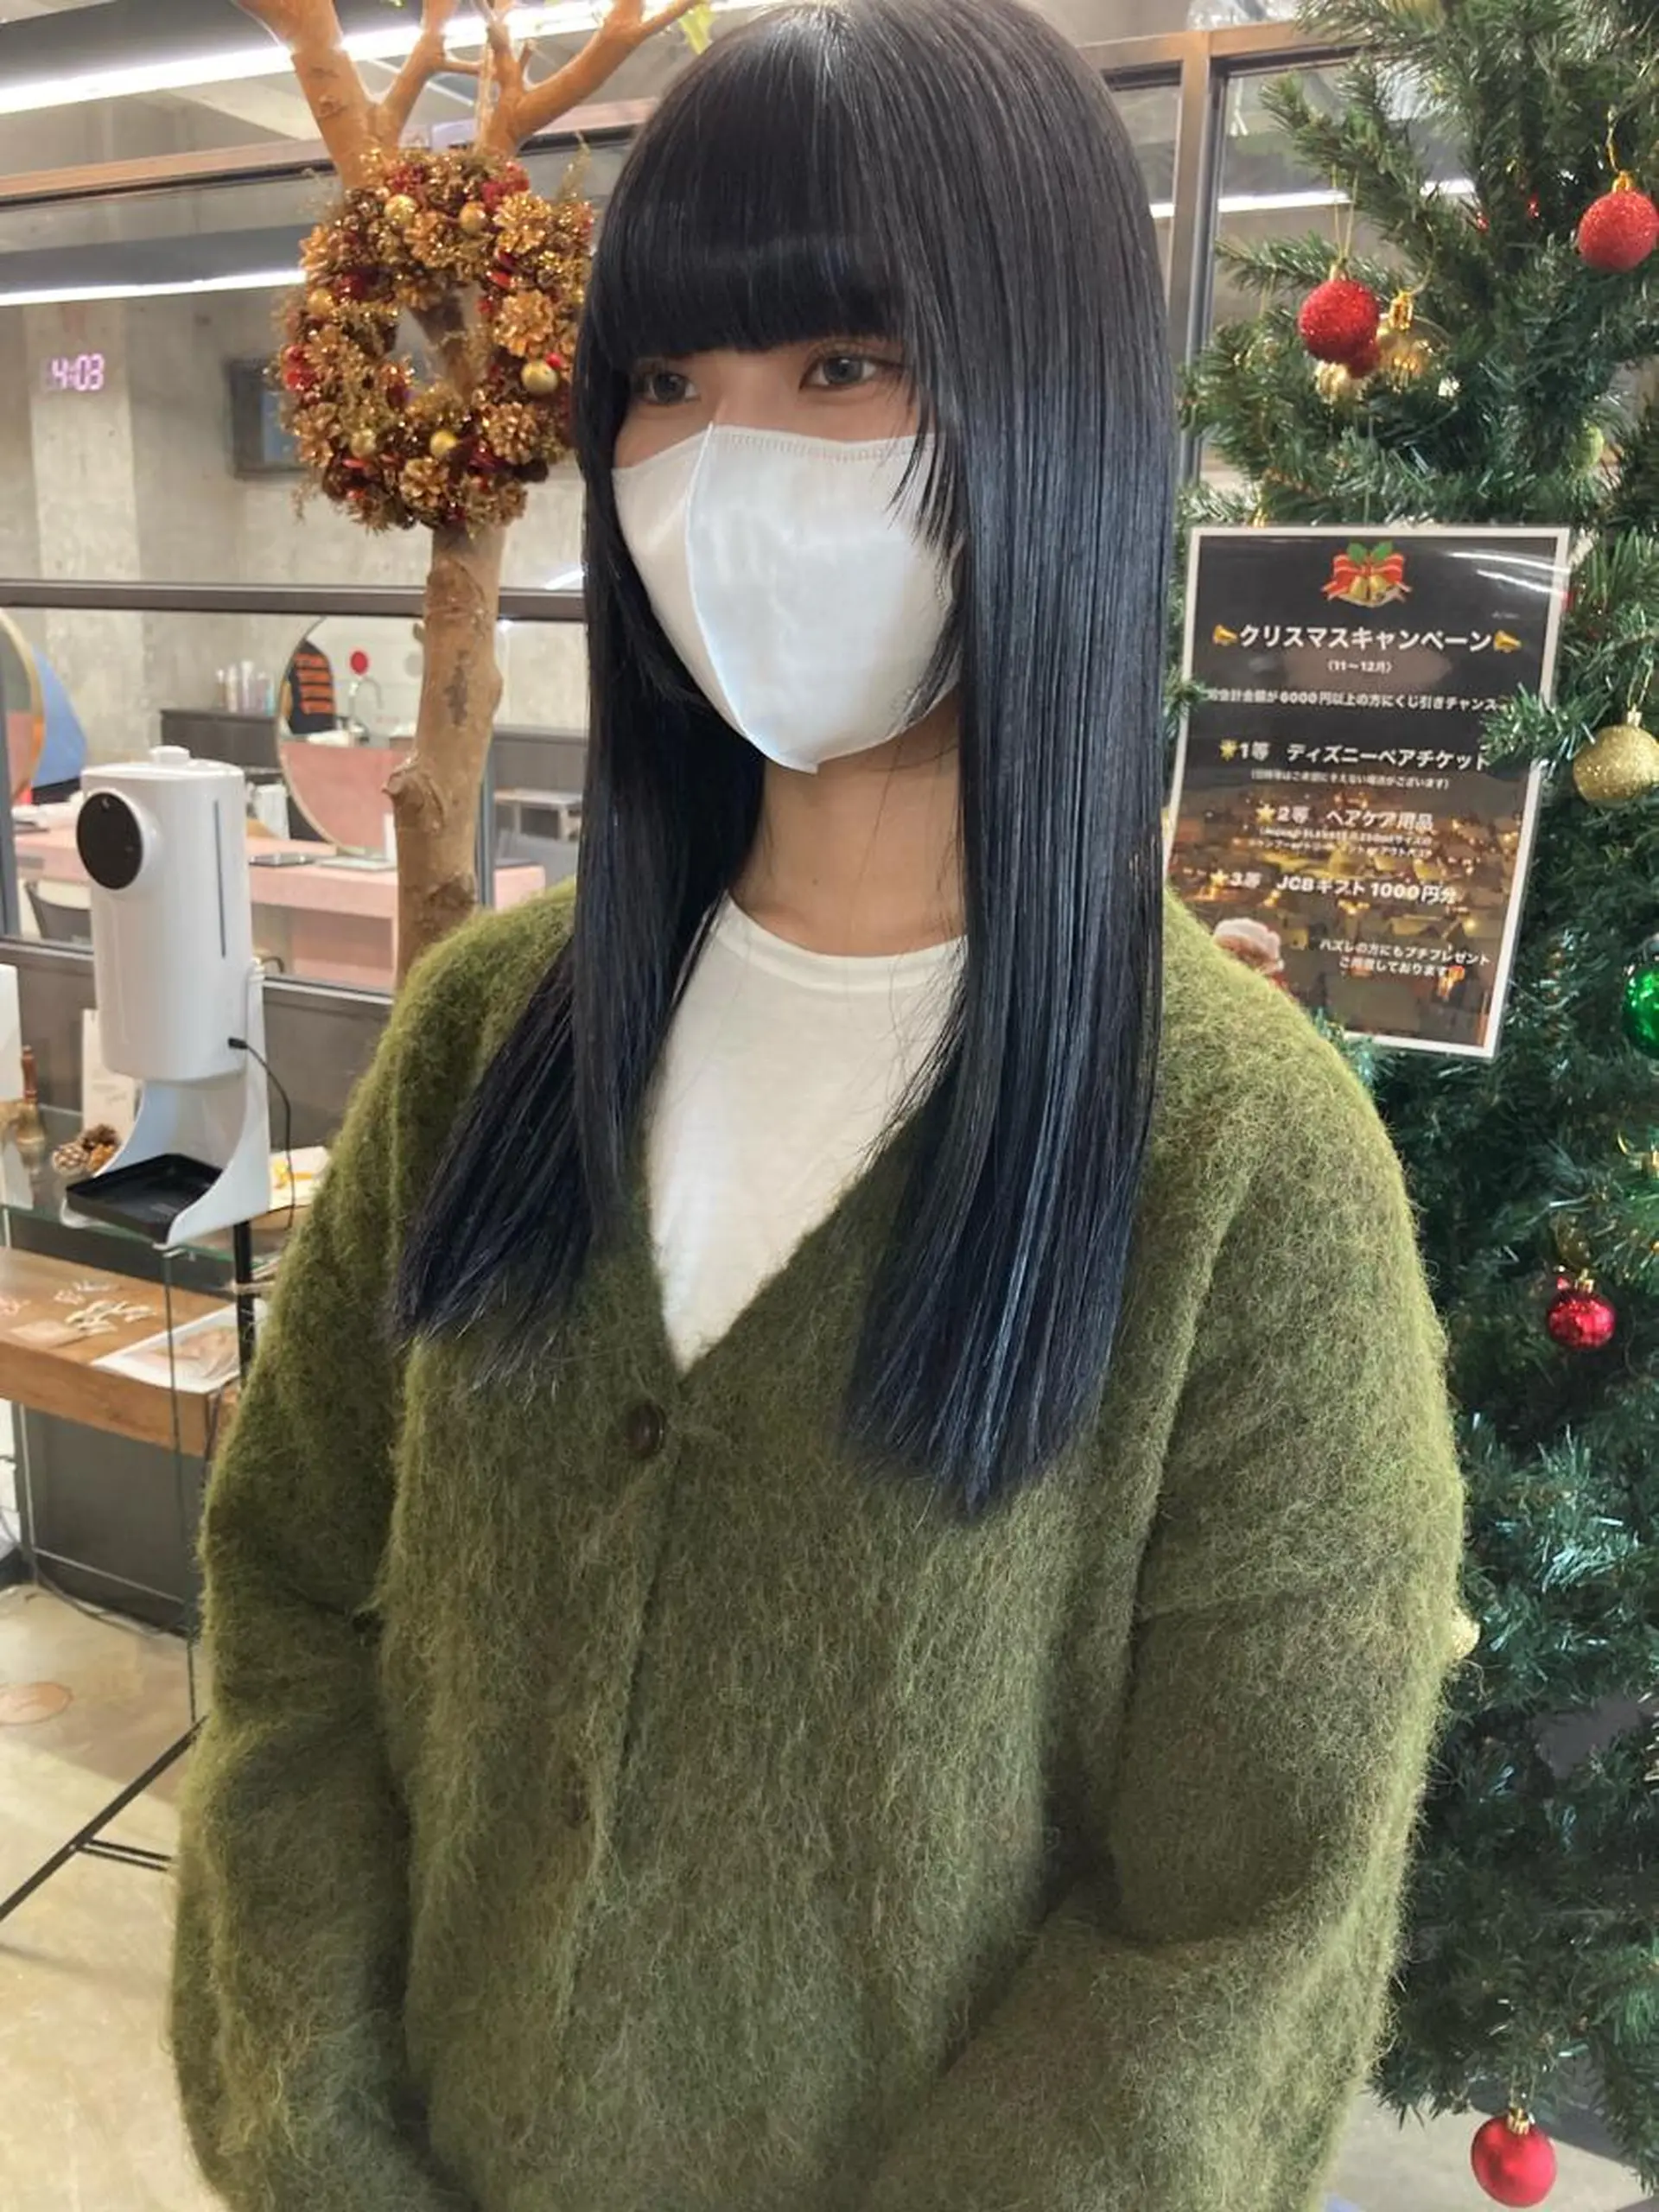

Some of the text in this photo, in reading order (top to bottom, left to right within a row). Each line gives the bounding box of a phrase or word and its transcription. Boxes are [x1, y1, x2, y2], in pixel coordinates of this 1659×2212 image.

[1239, 624, 1492, 652] クリスマスキャンペーン
[1239, 741, 1491, 772] 1等 ディズニーペアチケット
[1326, 810, 1434, 832] ヘアケア用品
